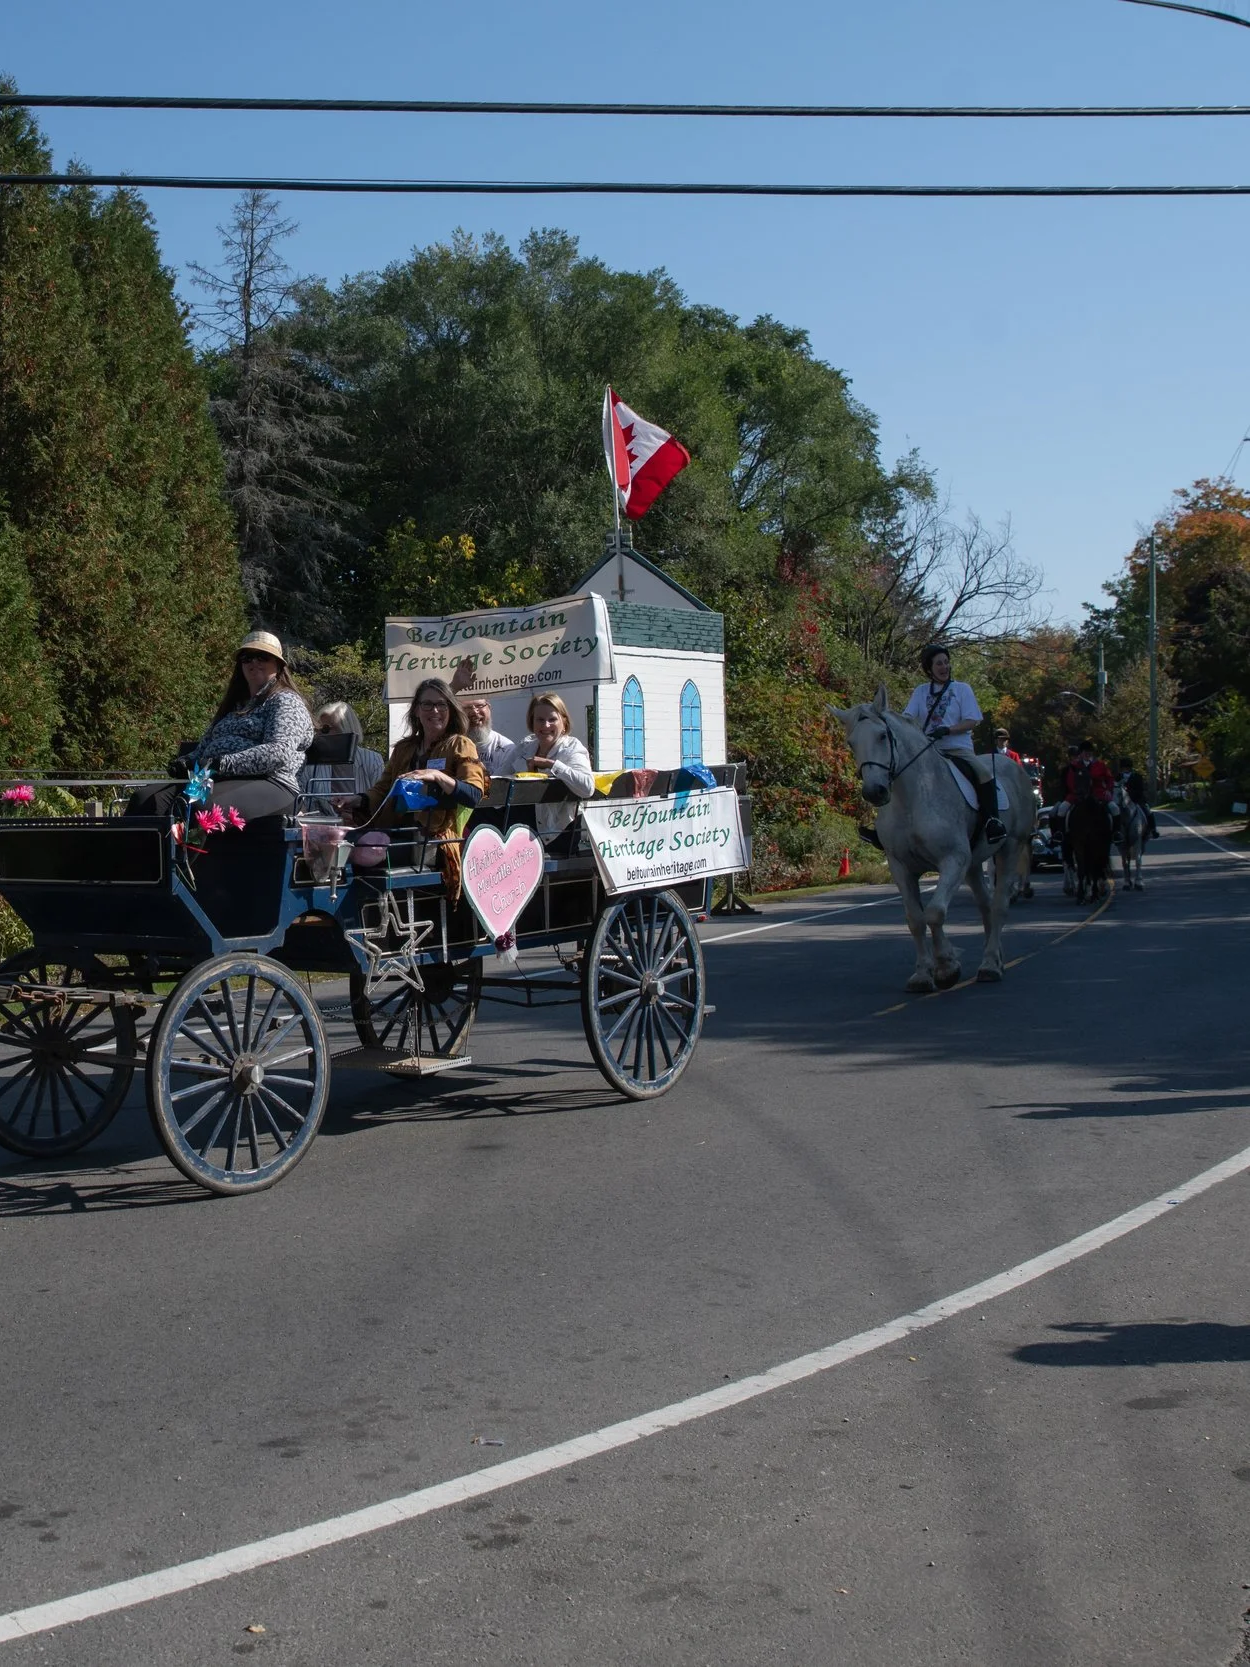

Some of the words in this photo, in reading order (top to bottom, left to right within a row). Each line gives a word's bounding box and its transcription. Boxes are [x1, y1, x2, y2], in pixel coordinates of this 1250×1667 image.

[406, 610, 568, 648] Belfountain
[499, 636, 599, 665] Society
[607, 798, 711, 832] Belfountain
[596, 838, 665, 860] Heritage
[669, 826, 731, 851] Society
[491, 876, 527, 915] Church
